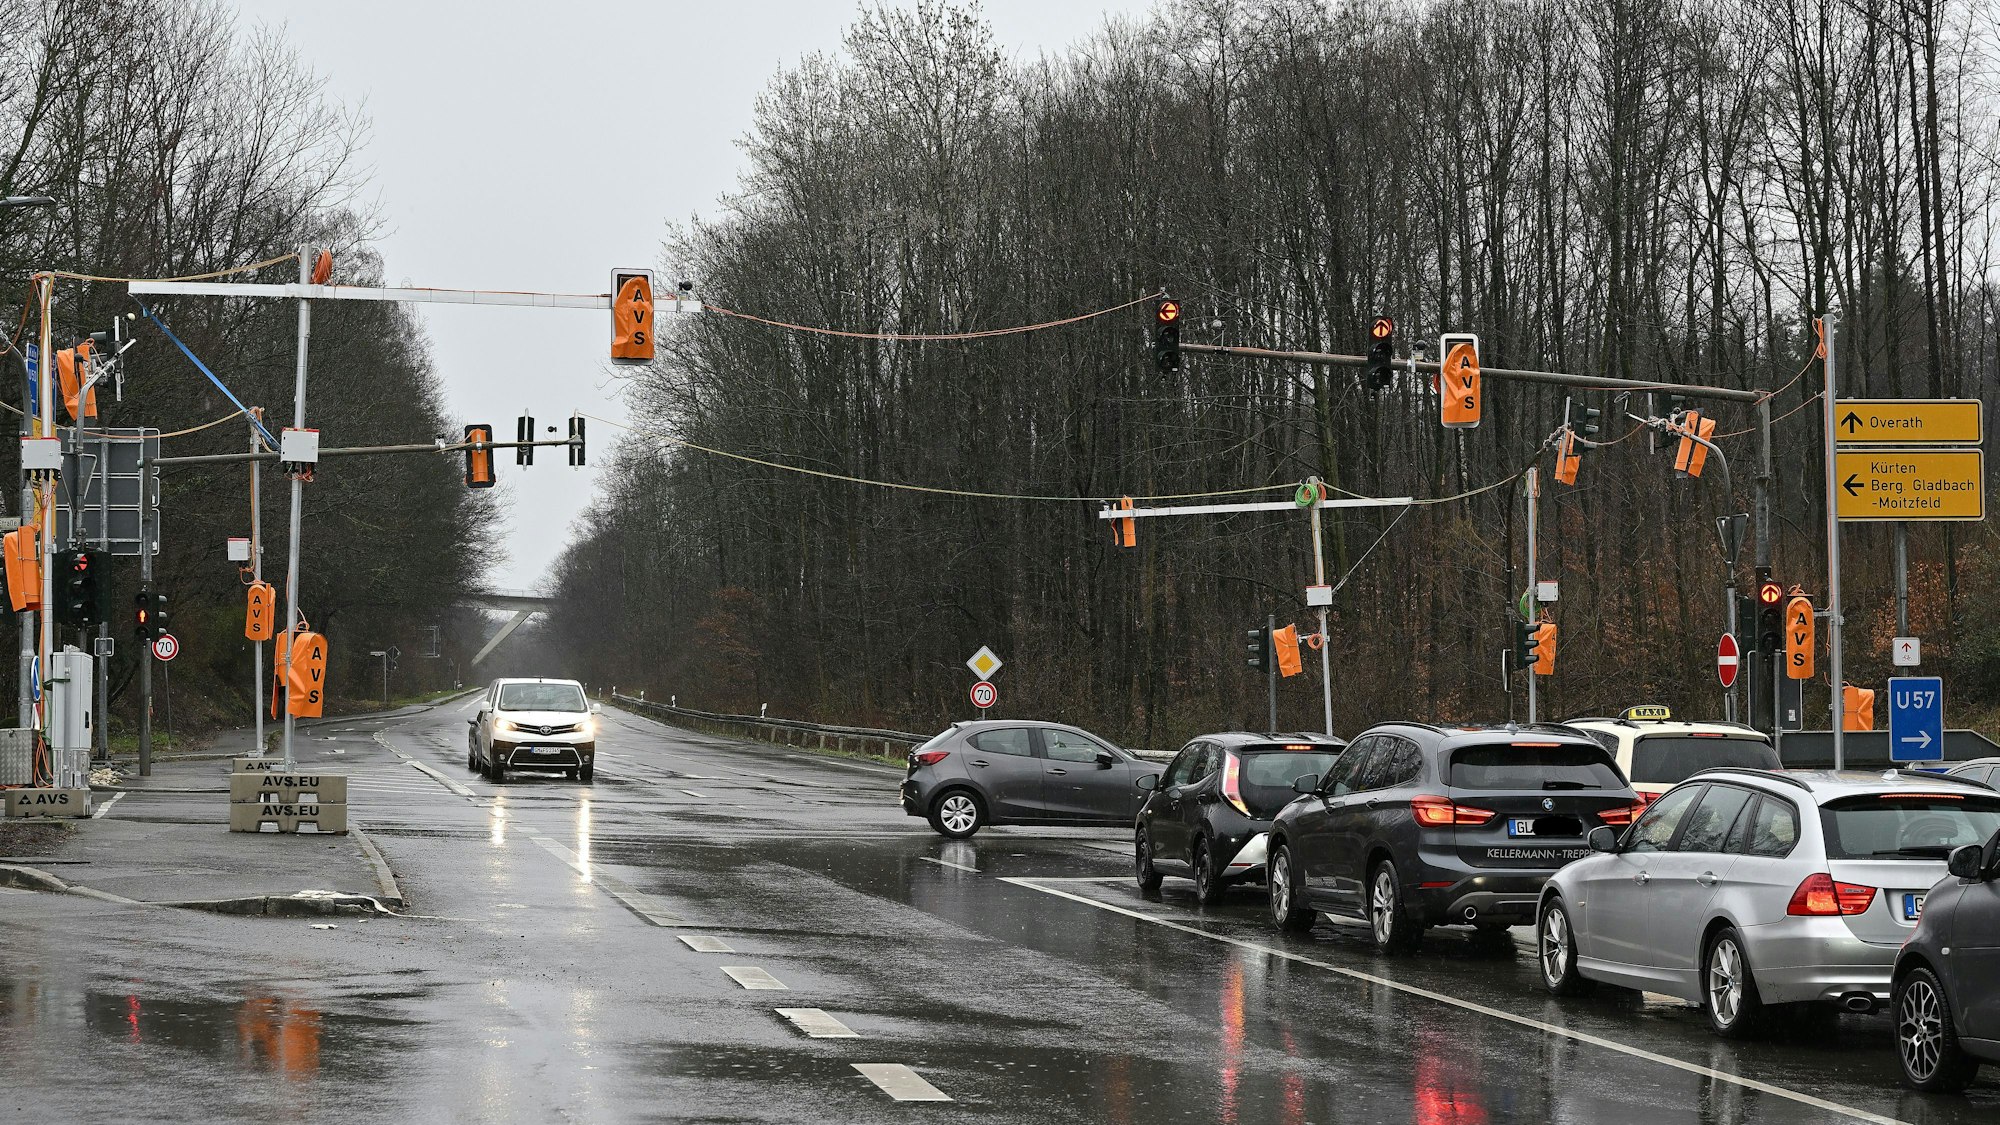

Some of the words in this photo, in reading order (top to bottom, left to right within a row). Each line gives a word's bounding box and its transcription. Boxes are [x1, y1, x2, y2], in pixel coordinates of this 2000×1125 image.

[632, 288, 646, 346] AVS
[1460, 355, 1475, 410] AVS
[1869, 416, 1923, 429] Overath
[1871, 461, 1917, 474] Kürten
[1871, 479, 1907, 495] Berg.
[1912, 478, 1975, 492] Gladbach
[1871, 496, 1942, 509] -Moitzfeld
[252, 595, 262, 632] AVS
[1793, 612, 1808, 667] AVS
[158, 641, 173, 653] 70
[977, 689, 991, 701] 70
[262, 776, 320, 787] AVS.EU
[36, 793, 69, 805] AVS
[262, 805, 320, 816] AVS.EU
